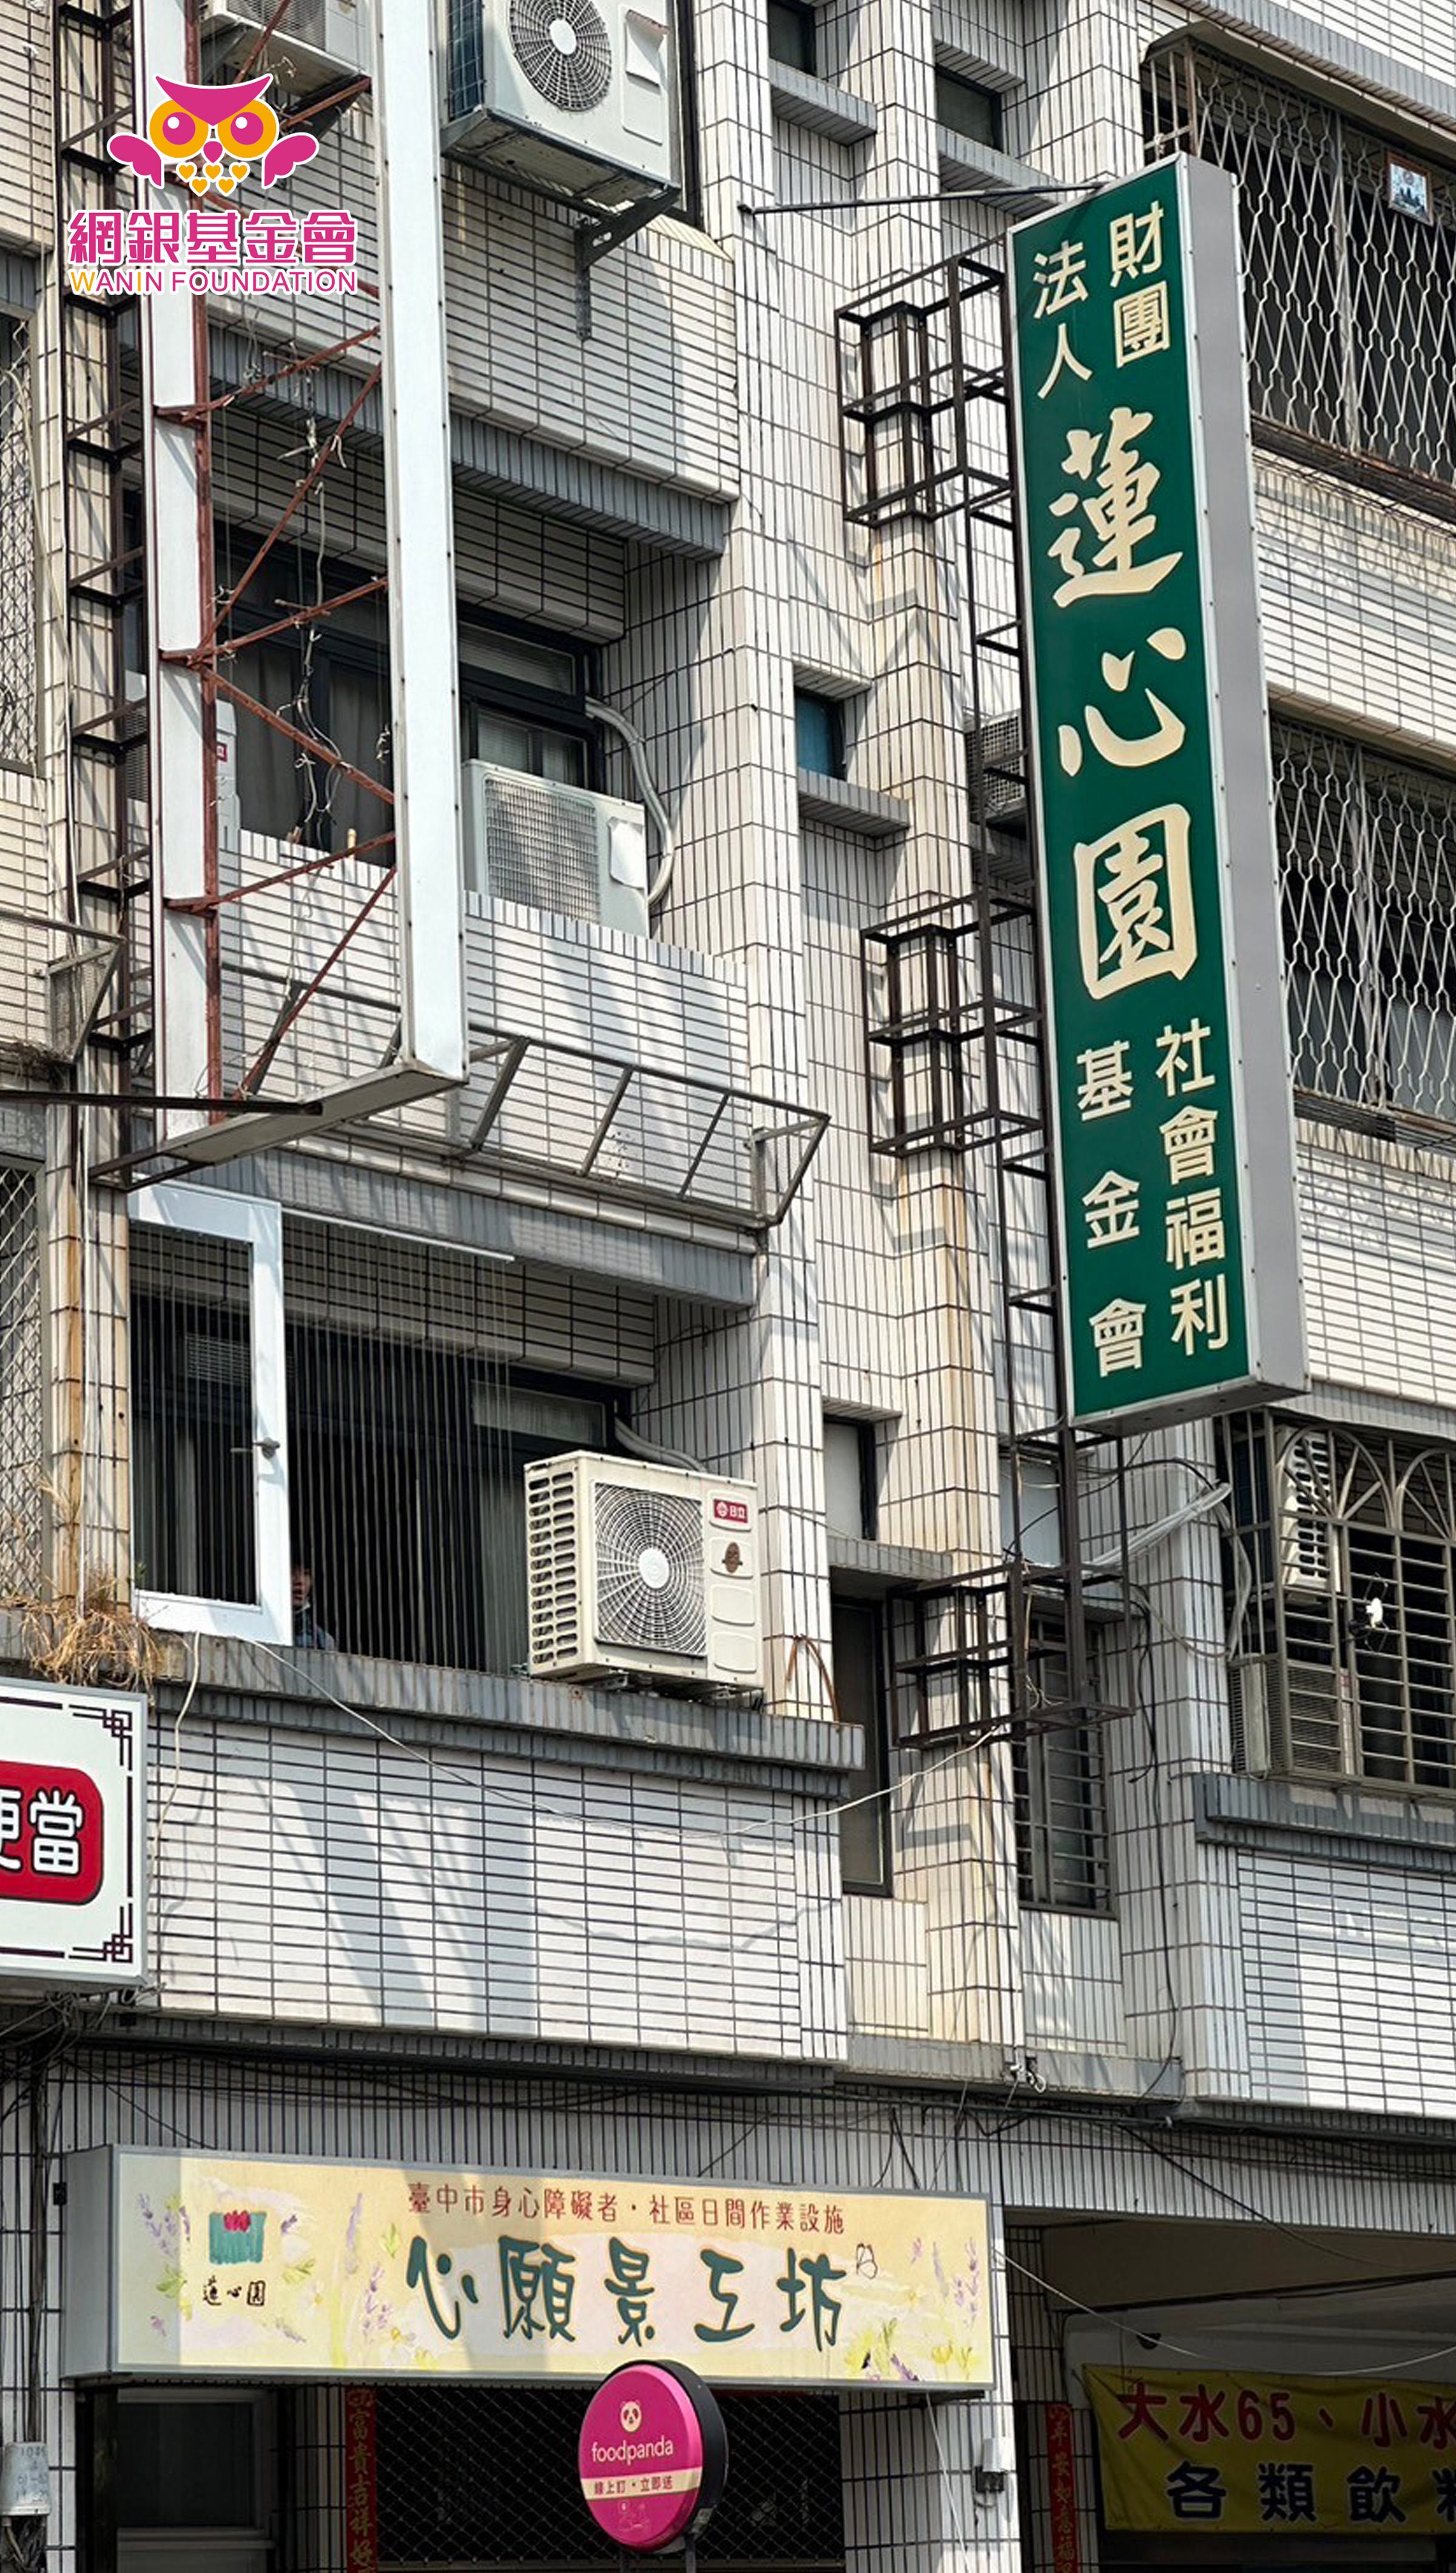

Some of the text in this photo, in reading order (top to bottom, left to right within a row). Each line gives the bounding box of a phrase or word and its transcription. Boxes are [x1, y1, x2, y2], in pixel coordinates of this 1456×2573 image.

[1033, 241, 1093, 399] 法人
[1109, 201, 1170, 368] 財團
[1047, 407, 1198, 1000] 蓮心園
[1077, 1040, 1147, 1378] 基金會
[1156, 1018, 1230, 1356] 社會福利
[406, 2235, 848, 2353] 心願景工坊
[348, 2407, 374, 2573] 富貴吉祥好
[592, 2435, 673, 2466] foodpanda
